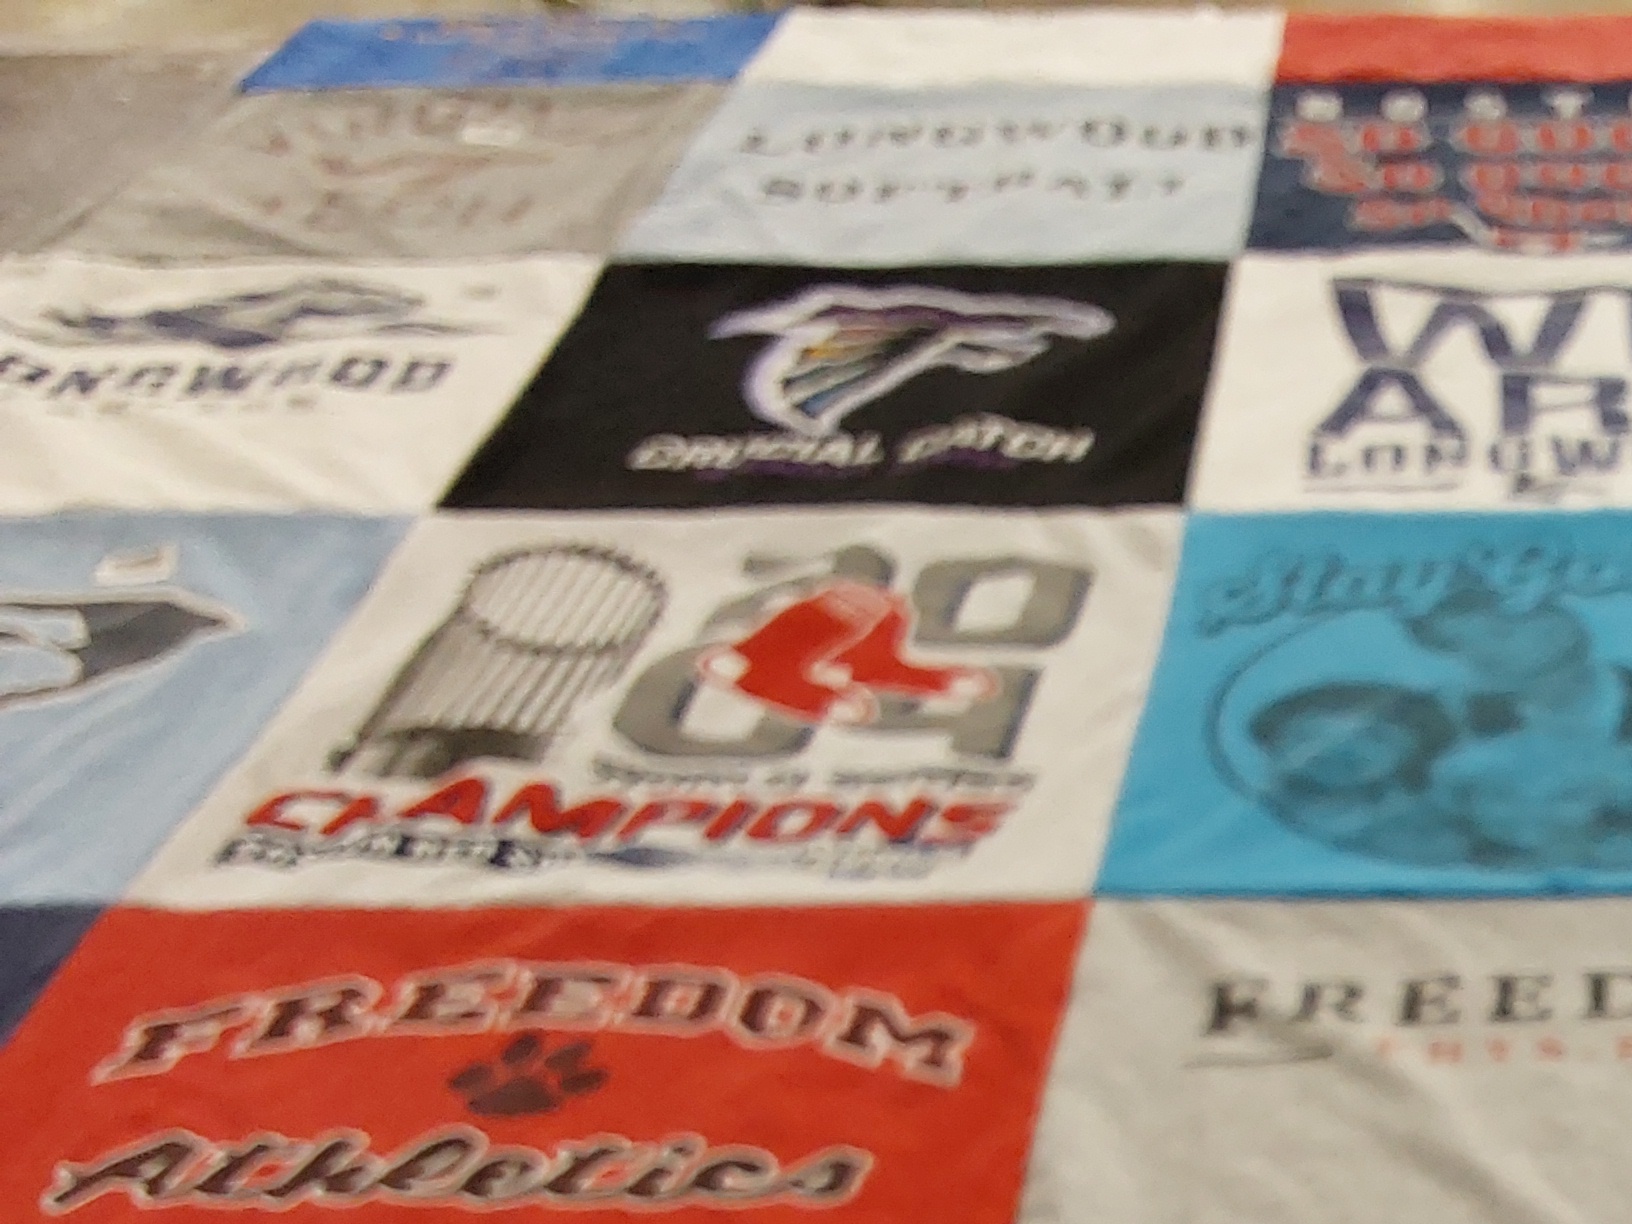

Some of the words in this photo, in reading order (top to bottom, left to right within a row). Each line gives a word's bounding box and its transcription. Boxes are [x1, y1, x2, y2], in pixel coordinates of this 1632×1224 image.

[0, 352, 456, 398] ONGWOOD
[90, 958, 976, 1088] FREEDOM
[40, 1124, 874, 1216] Athletics
